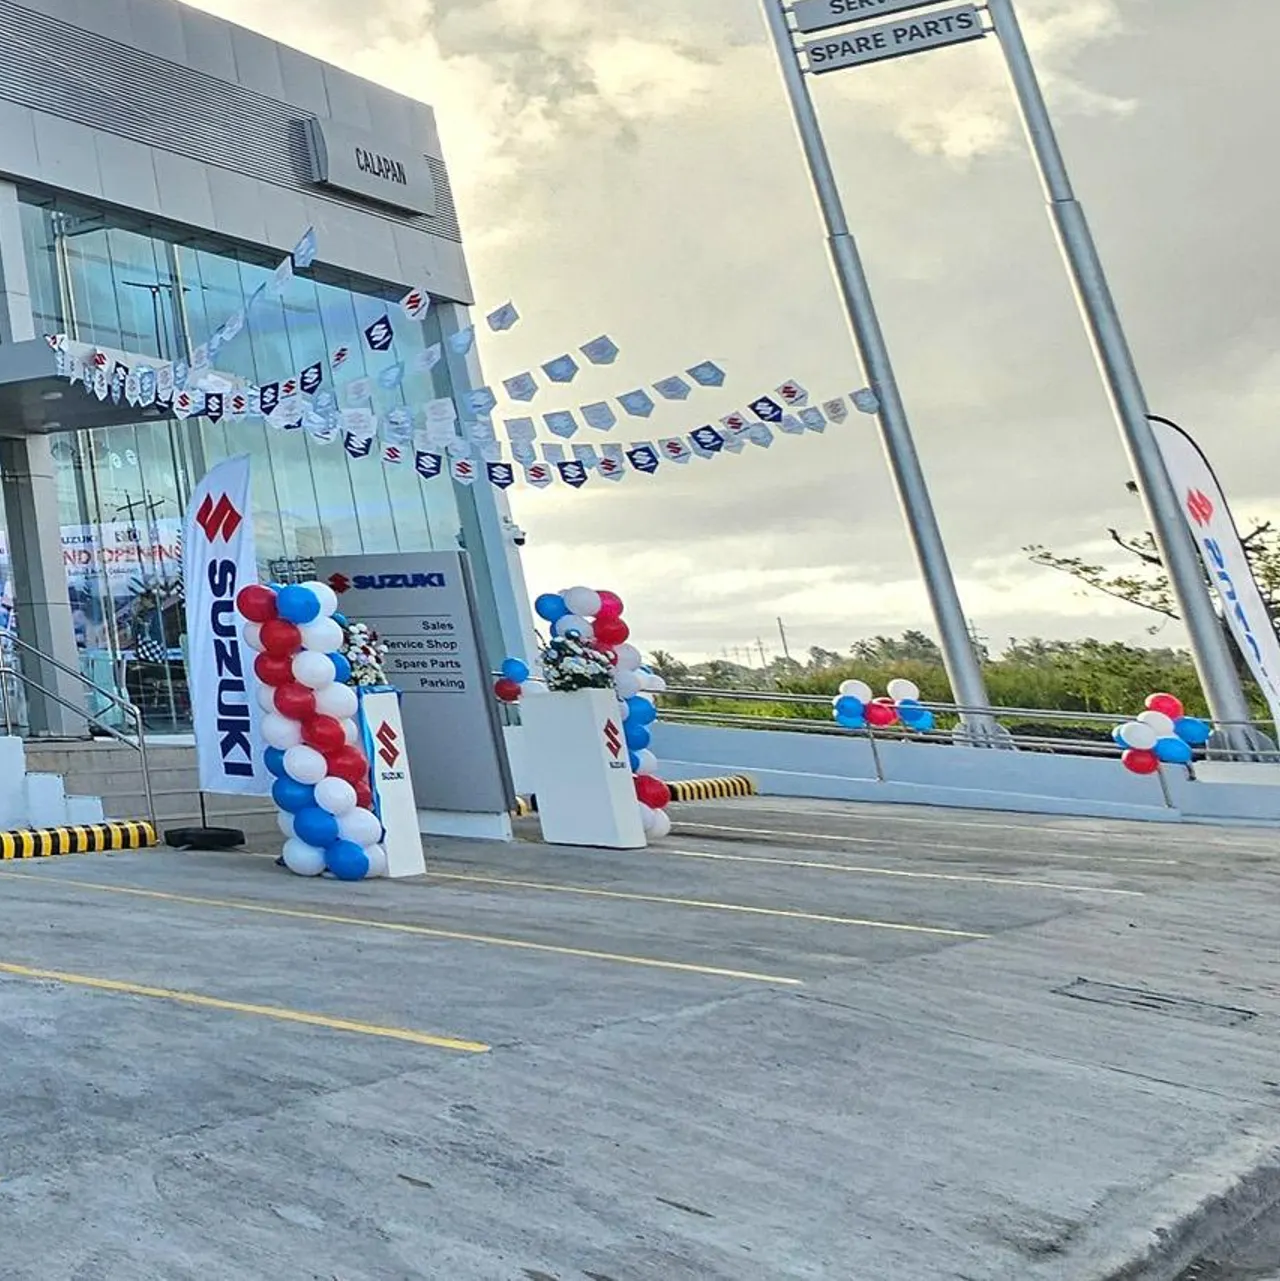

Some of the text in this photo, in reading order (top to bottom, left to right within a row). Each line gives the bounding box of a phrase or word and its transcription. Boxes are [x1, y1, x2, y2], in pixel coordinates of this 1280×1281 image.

[810, 12, 974, 63] SPARE PARTS
[355, 147, 407, 185] CALAPAN
[352, 572, 446, 589] SUZUKI
[422, 620, 454, 631] Sales
[383, 639, 458, 651] Service Shop
[207, 558, 255, 778] SUZUKI
[394, 658, 461, 670] Spare Parts
[420, 677, 465, 689] Parking
